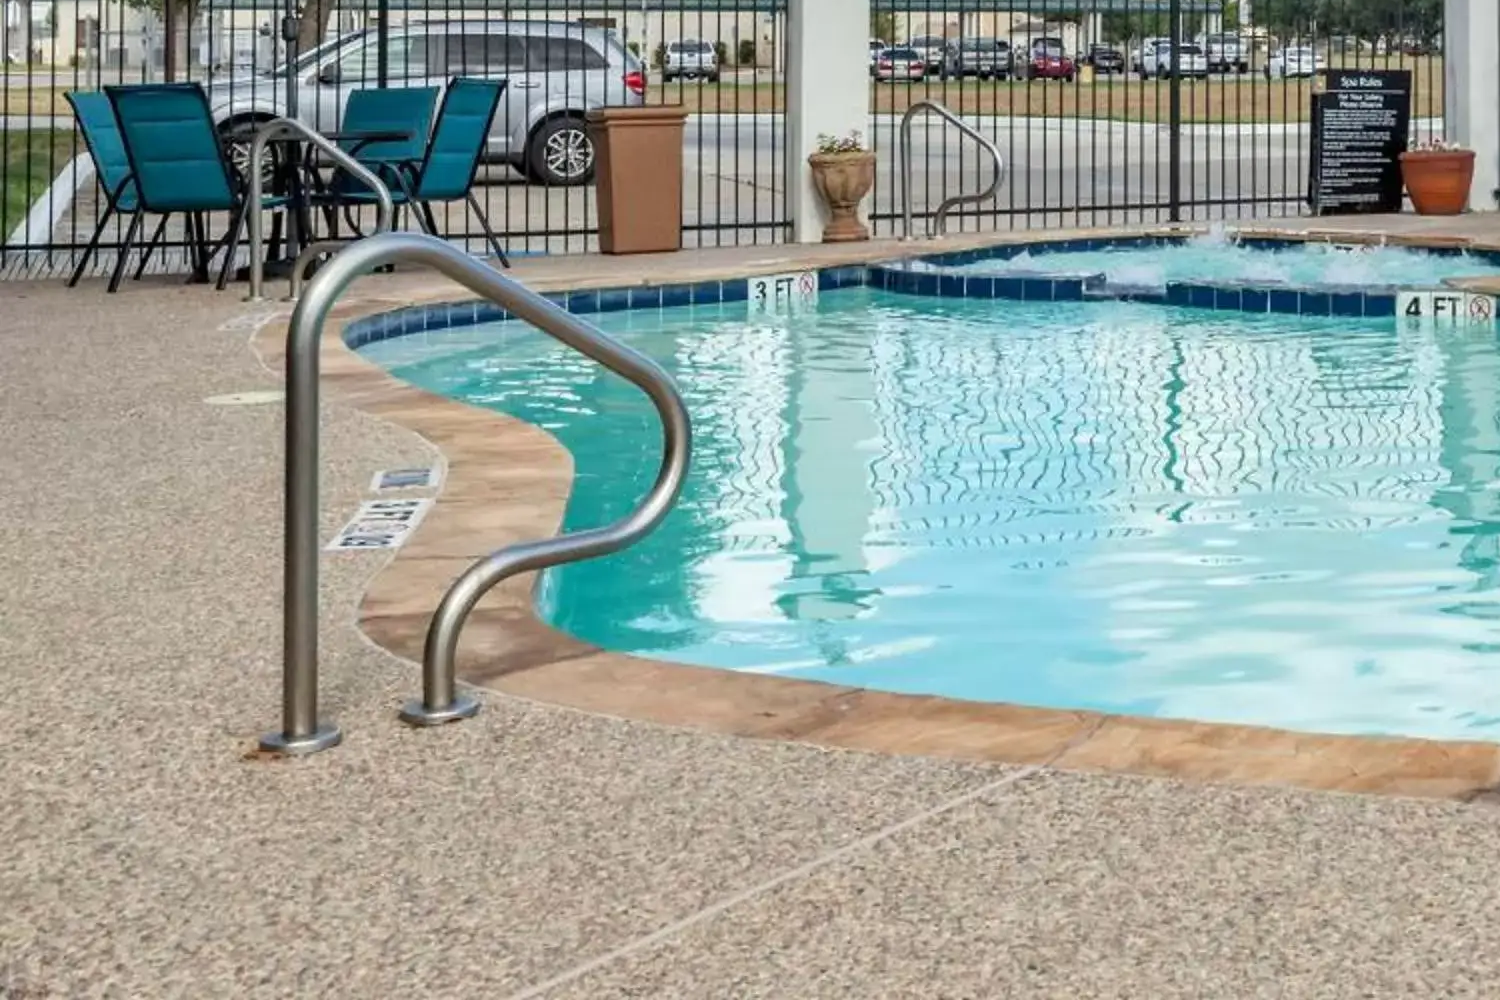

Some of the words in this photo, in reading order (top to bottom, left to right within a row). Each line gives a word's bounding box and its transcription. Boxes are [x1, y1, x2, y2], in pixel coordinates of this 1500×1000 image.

[1341, 76, 1358, 88] Spa
[1360, 76, 1382, 88] Rules
[755, 281, 767, 299] 3
[775, 277, 794, 300] FT
[1405, 296, 1421, 317] 4
[1433, 296, 1461, 317] FT
